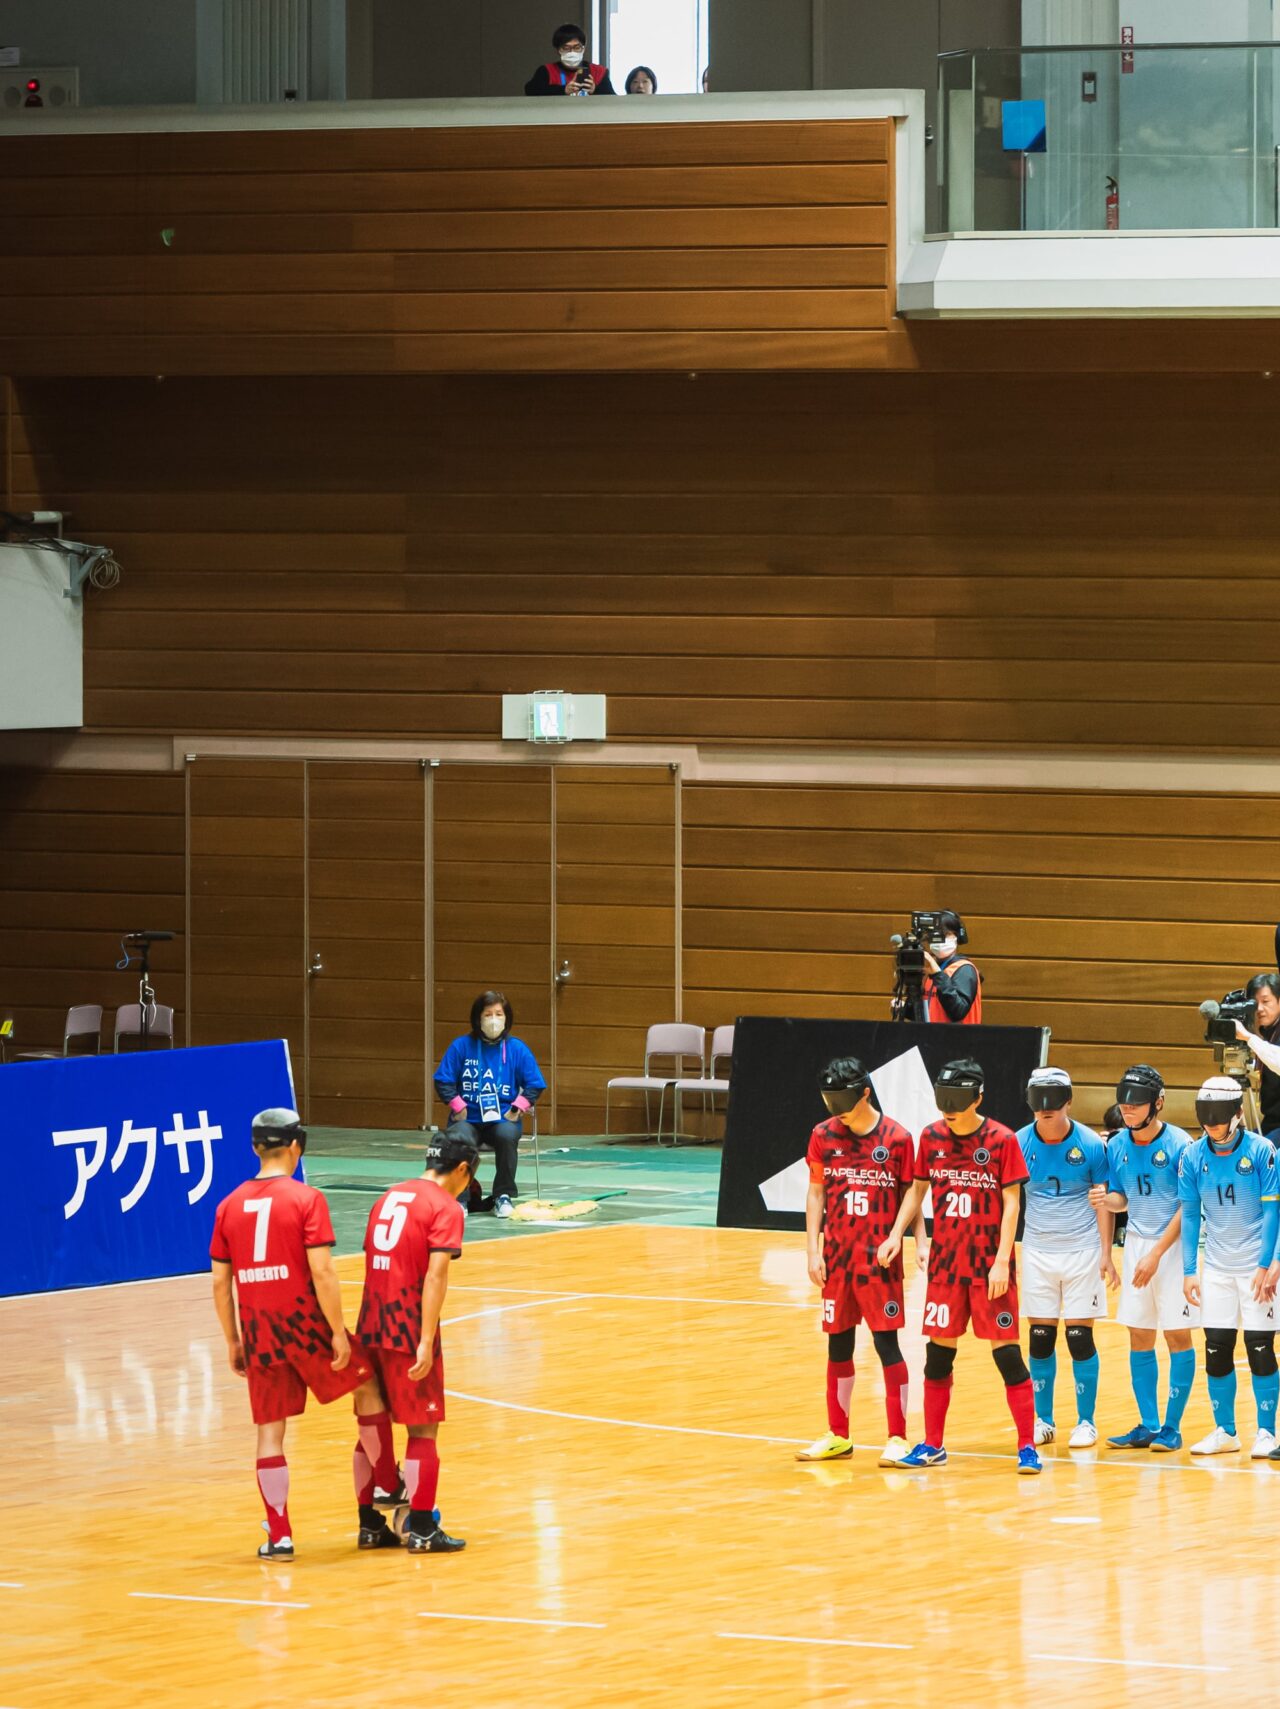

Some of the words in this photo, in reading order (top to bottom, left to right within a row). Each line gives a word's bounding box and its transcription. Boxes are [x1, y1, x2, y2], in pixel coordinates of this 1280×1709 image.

[52, 1110, 223, 1220] アクサ
[823, 1168, 896, 1181] PAPELECIAL
[1048, 1176, 1061, 1197] 7
[1137, 1174, 1152, 1196] 15
[1216, 1183, 1236, 1206] 14
[844, 1191, 869, 1216] 15
[945, 1192, 972, 1218] 20
[243, 1197, 273, 1263] 7
[373, 1191, 417, 1252] 5
[924, 1302, 950, 1328] 20
